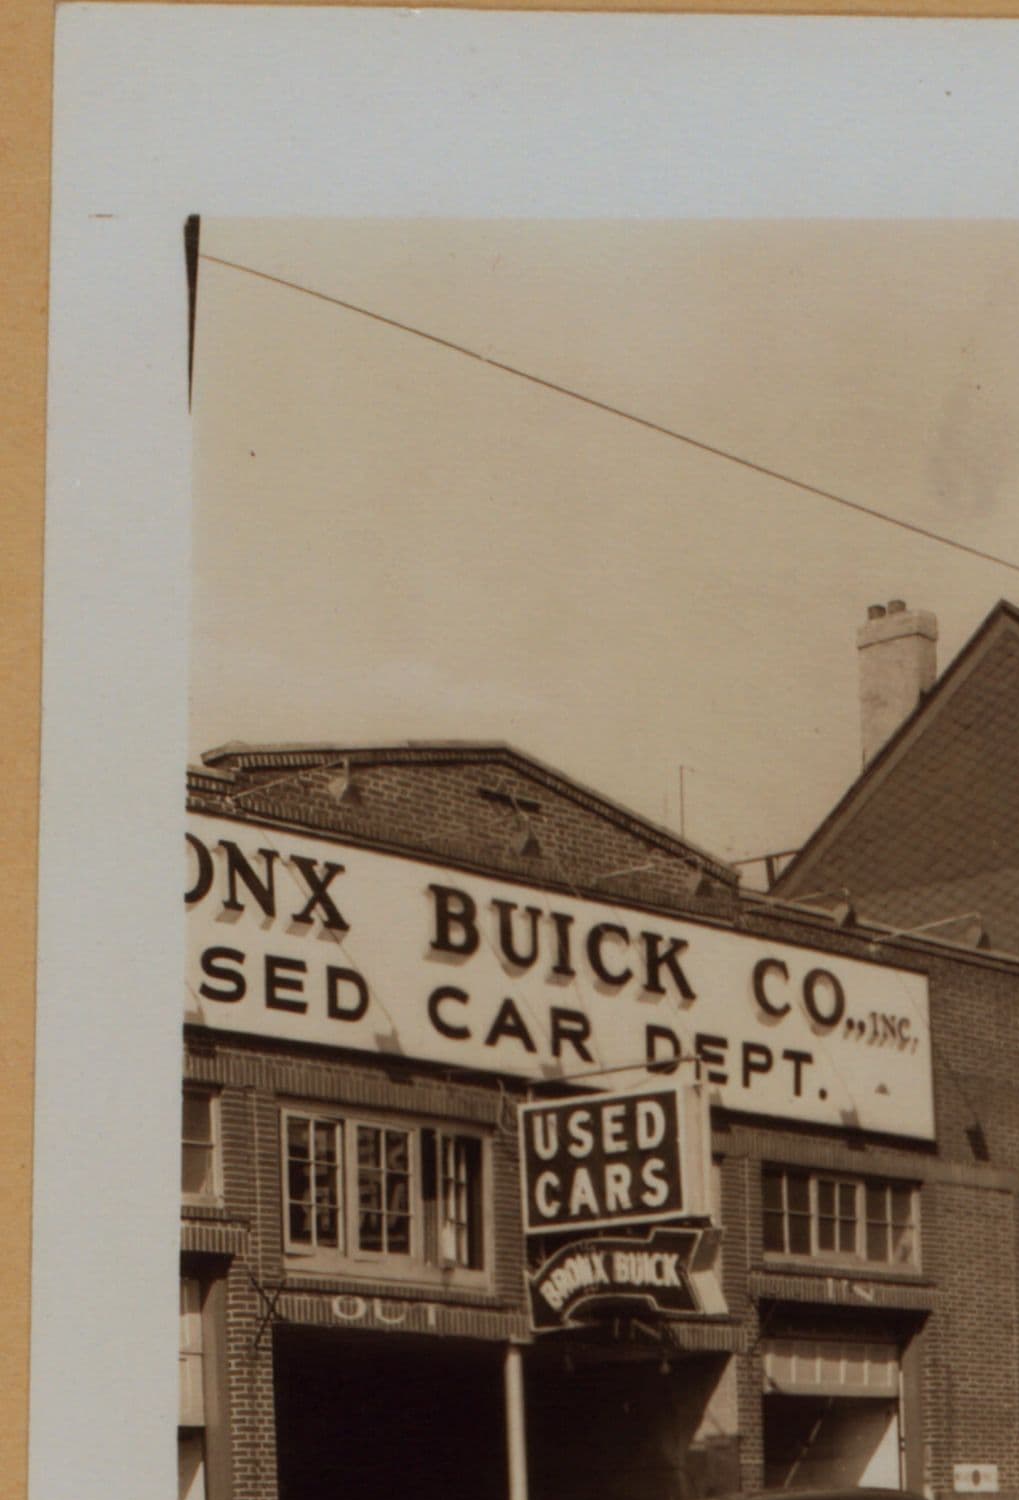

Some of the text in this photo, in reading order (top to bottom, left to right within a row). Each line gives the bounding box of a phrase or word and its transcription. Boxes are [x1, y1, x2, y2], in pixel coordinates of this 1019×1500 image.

[428, 883, 697, 1001] BUICK
[427, 985, 595, 1064] CAR
[646, 1023, 829, 1100] DEPT.
[532, 1100, 666, 1161] USED
[534, 1157, 670, 1218] CARS
[332, 1294, 450, 1328] OUT
[539, 1251, 683, 1311] BRONX BUICK
[826, 1276, 875, 1303] IN
